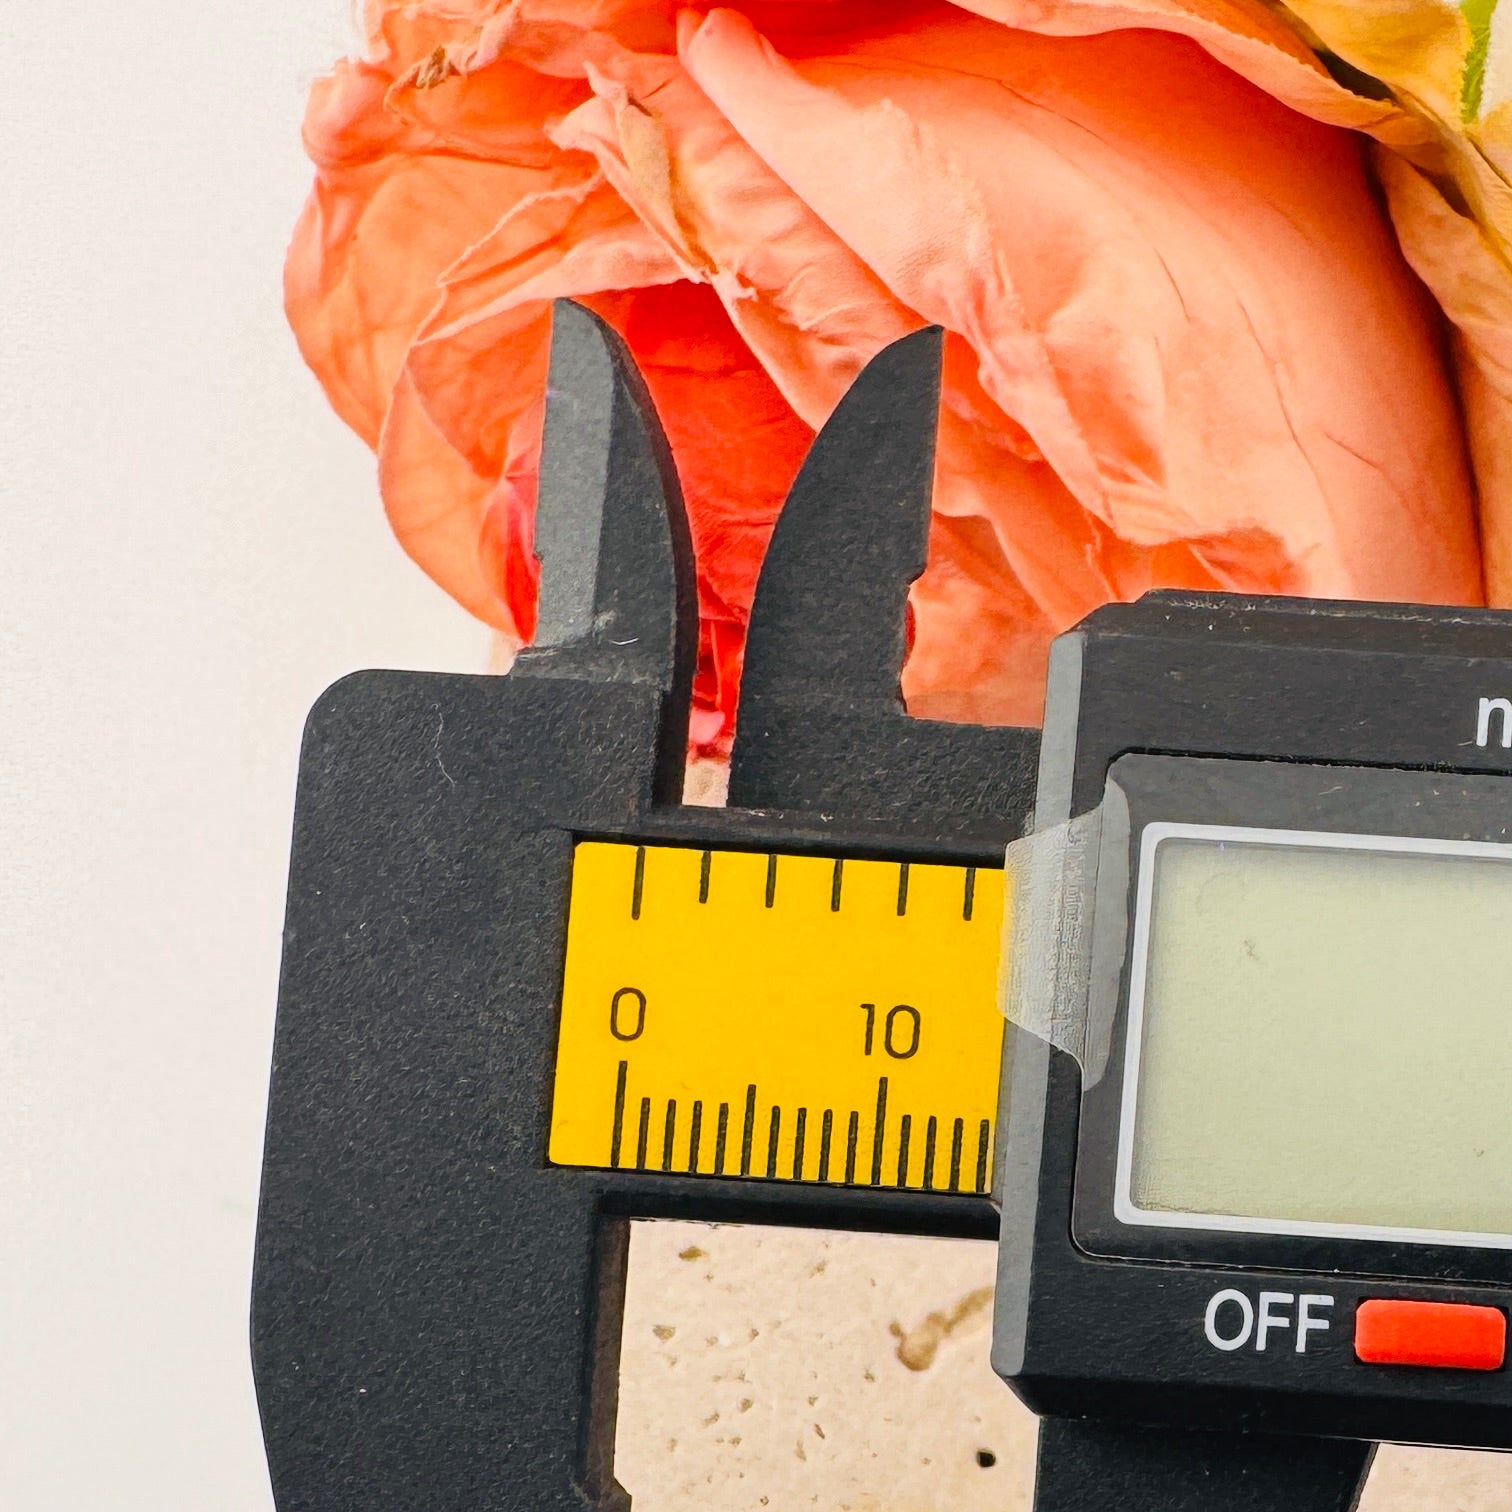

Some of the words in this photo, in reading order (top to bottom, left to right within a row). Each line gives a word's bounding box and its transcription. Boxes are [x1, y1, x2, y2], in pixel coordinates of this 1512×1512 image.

[609, 986, 647, 1042] 0
[859, 1003, 921, 1060] 10
[1203, 1288, 1335, 1354] OFF
